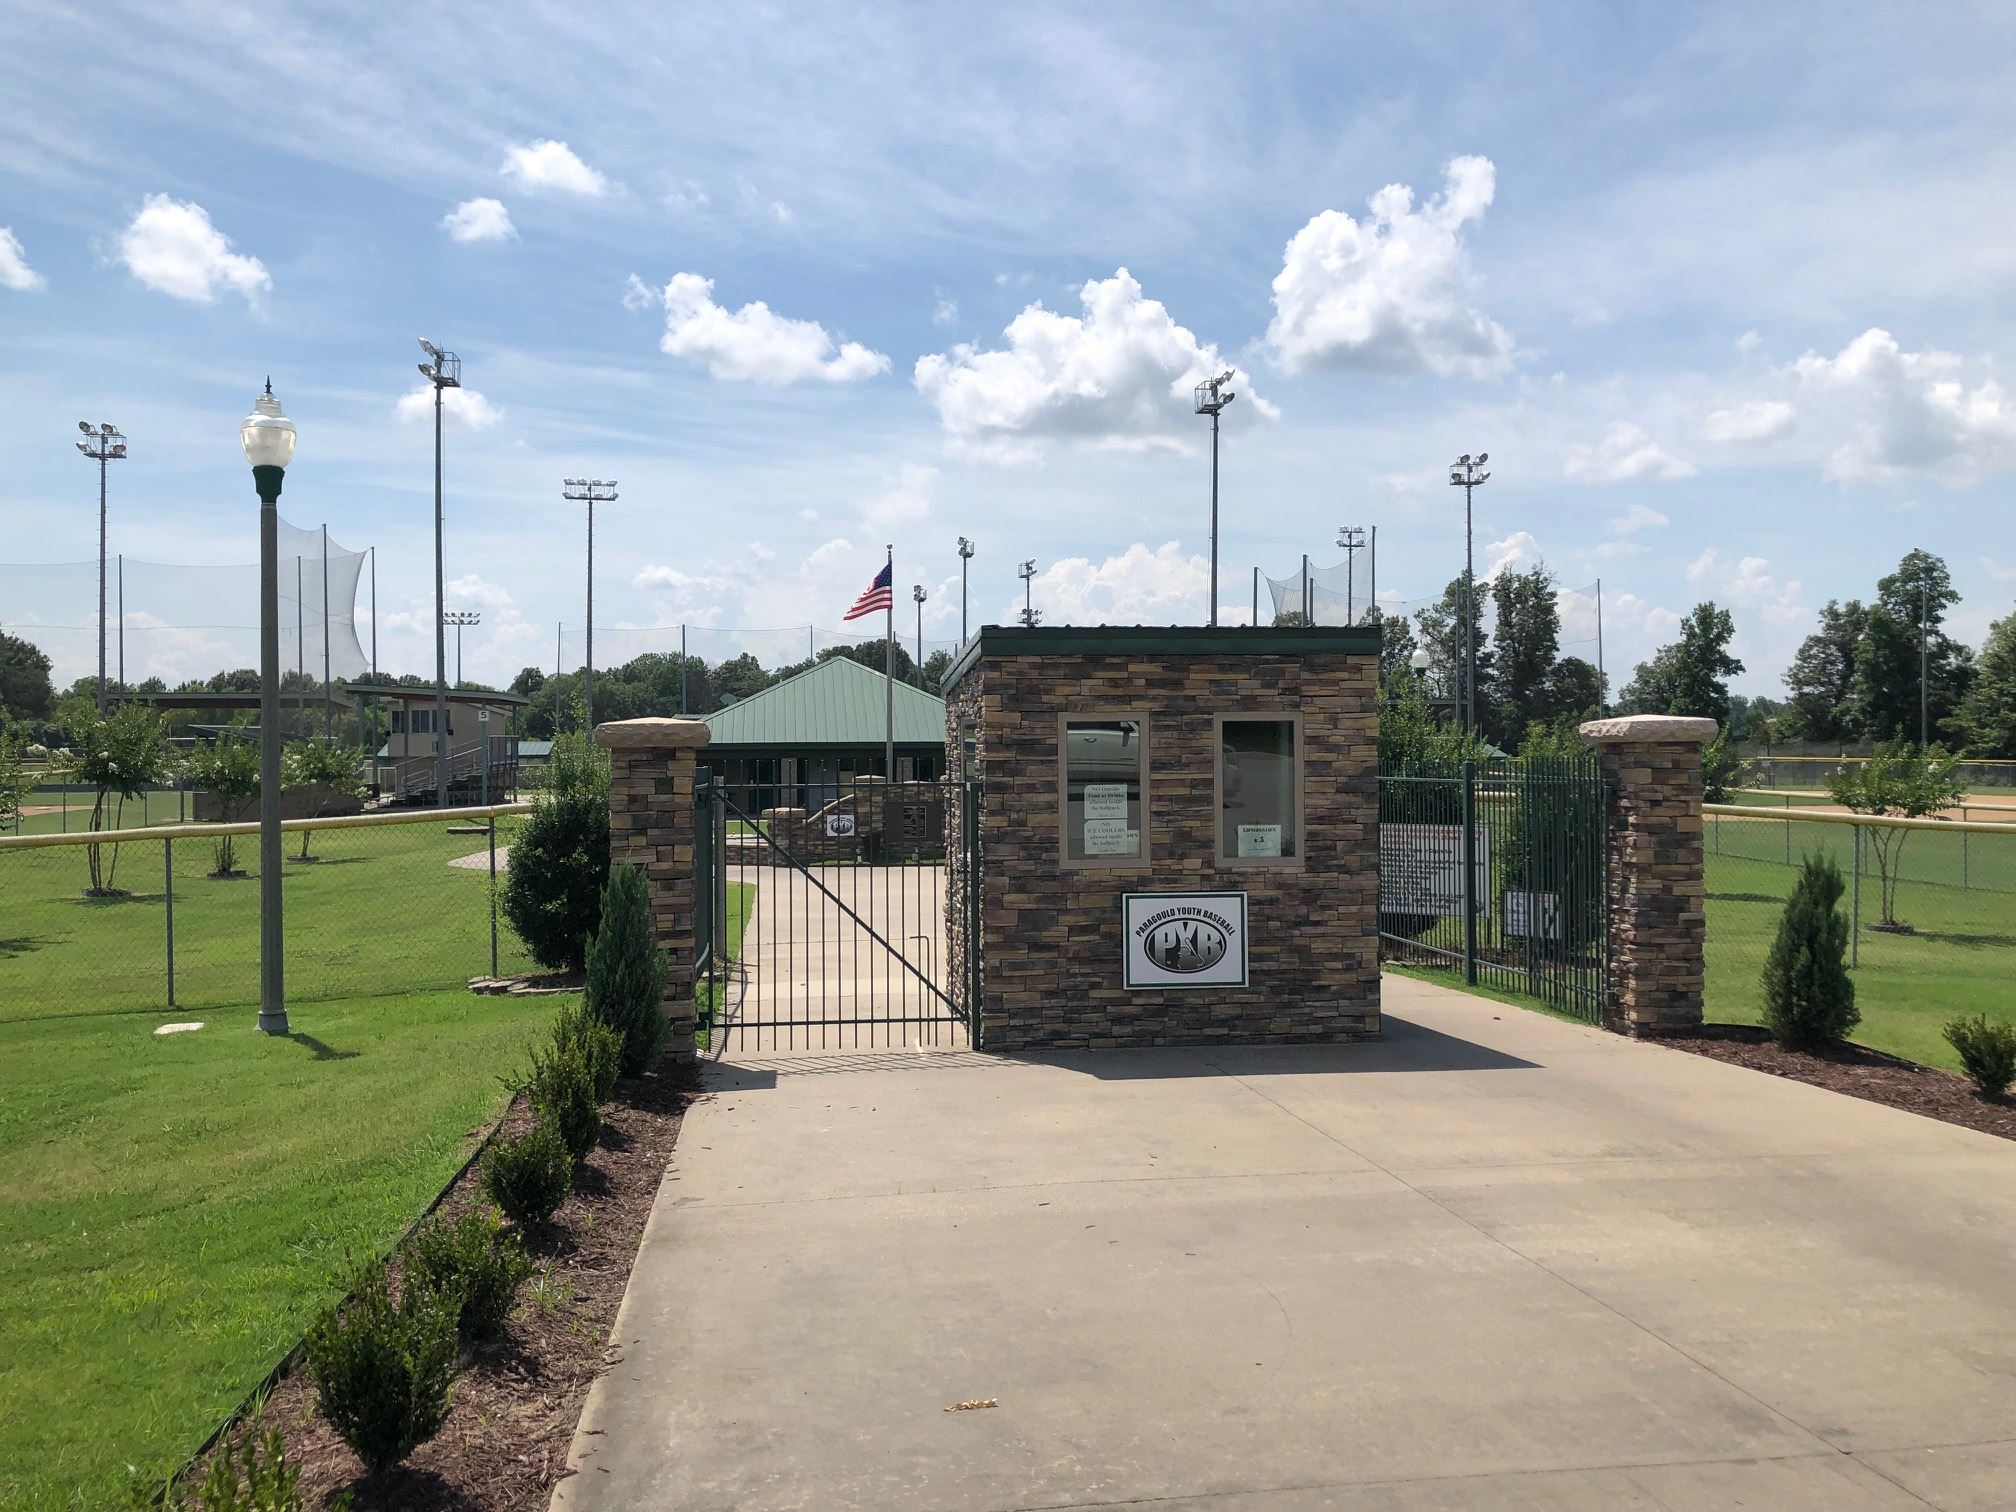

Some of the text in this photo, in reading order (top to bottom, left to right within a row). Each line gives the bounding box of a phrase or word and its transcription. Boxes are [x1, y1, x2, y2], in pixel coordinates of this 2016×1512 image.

[480, 711, 487, 719] 5
[1135, 906, 1236, 937] PARAGOULD YOUTH BASEBALL
[1154, 919, 1221, 961] PYB
